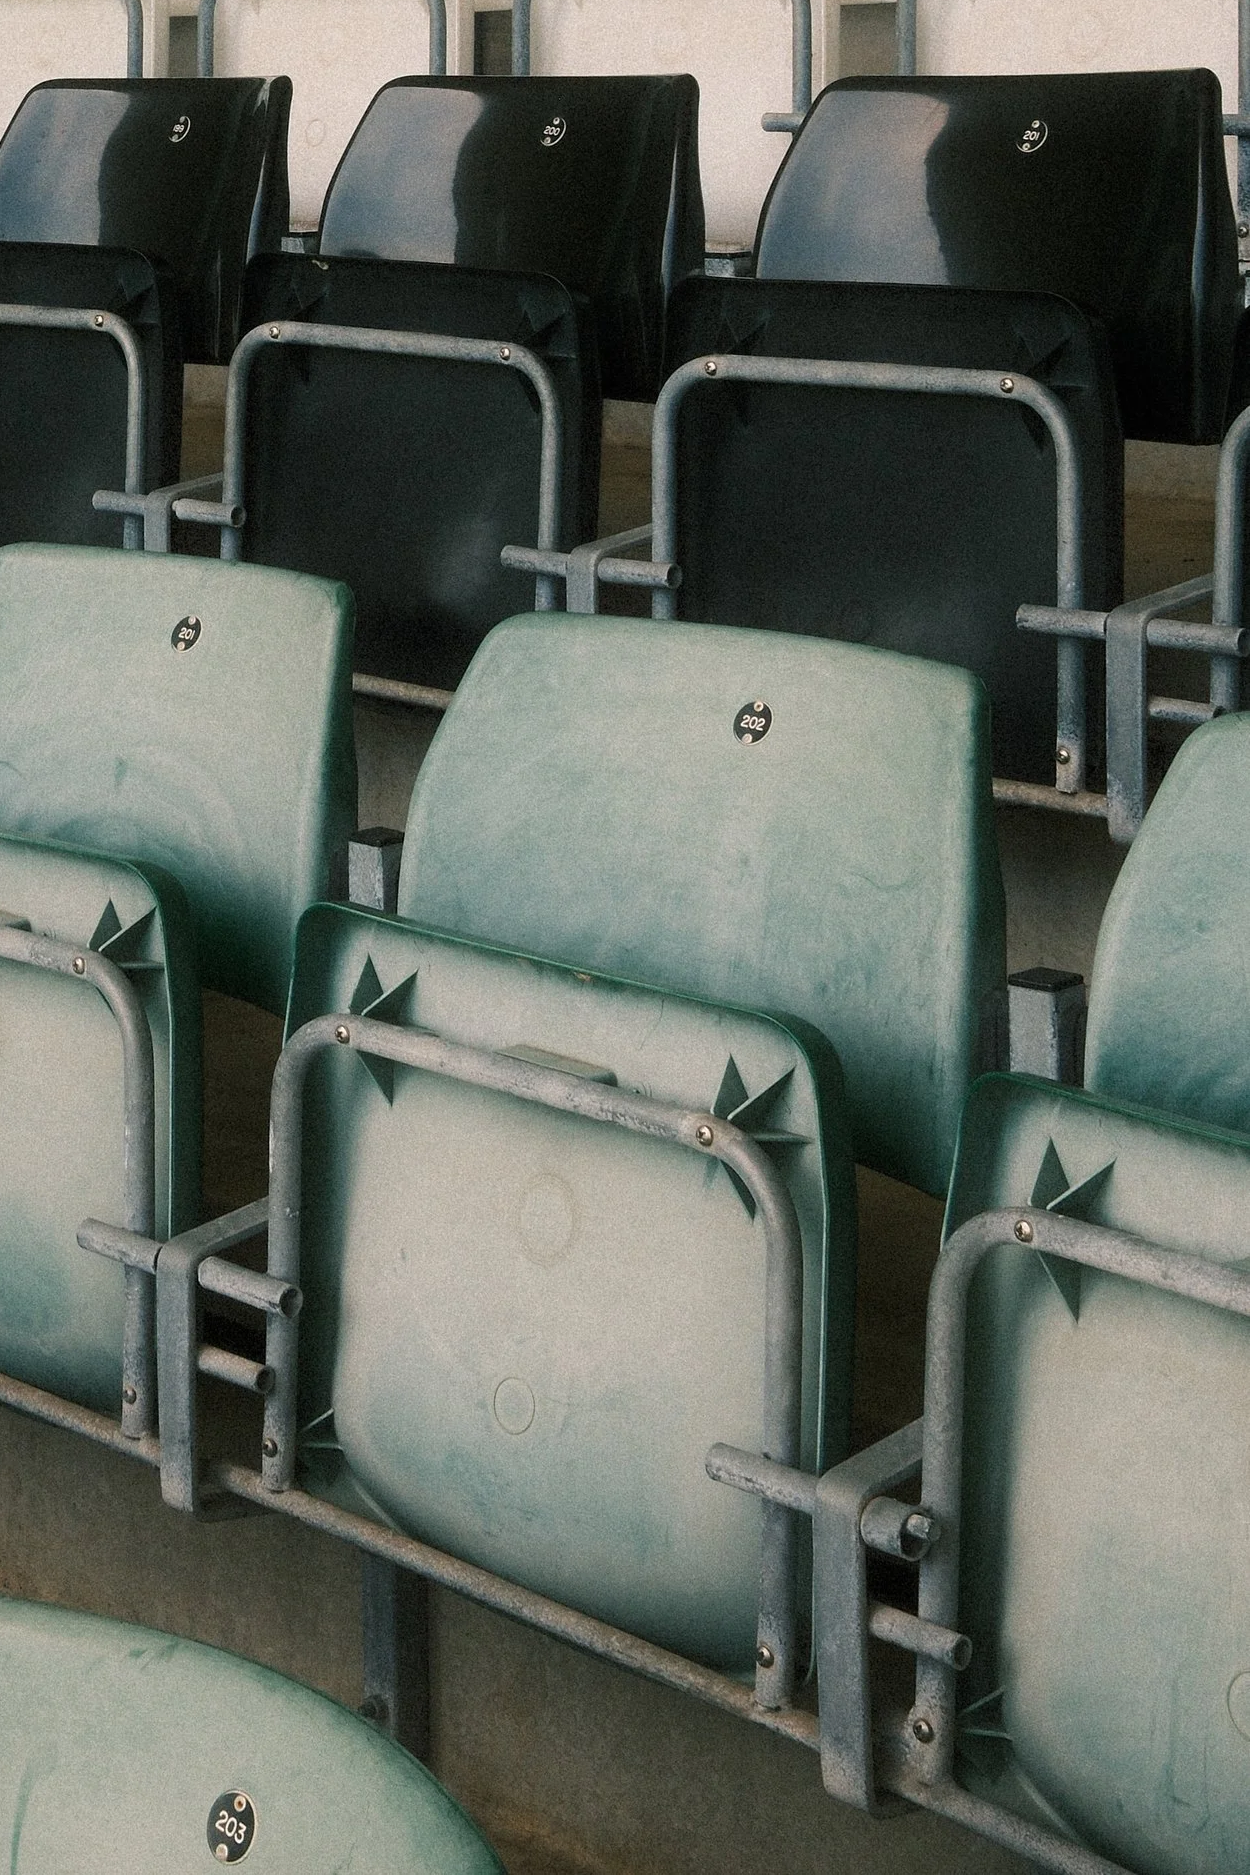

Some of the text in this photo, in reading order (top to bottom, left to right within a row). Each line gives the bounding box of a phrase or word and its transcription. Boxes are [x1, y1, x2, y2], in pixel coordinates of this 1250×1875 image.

[542, 125, 561, 137] 200
[1022, 129, 1041, 142] 201
[177, 626, 197, 641] 201
[739, 713, 766, 733] 202
[214, 1809, 248, 1845] 203
